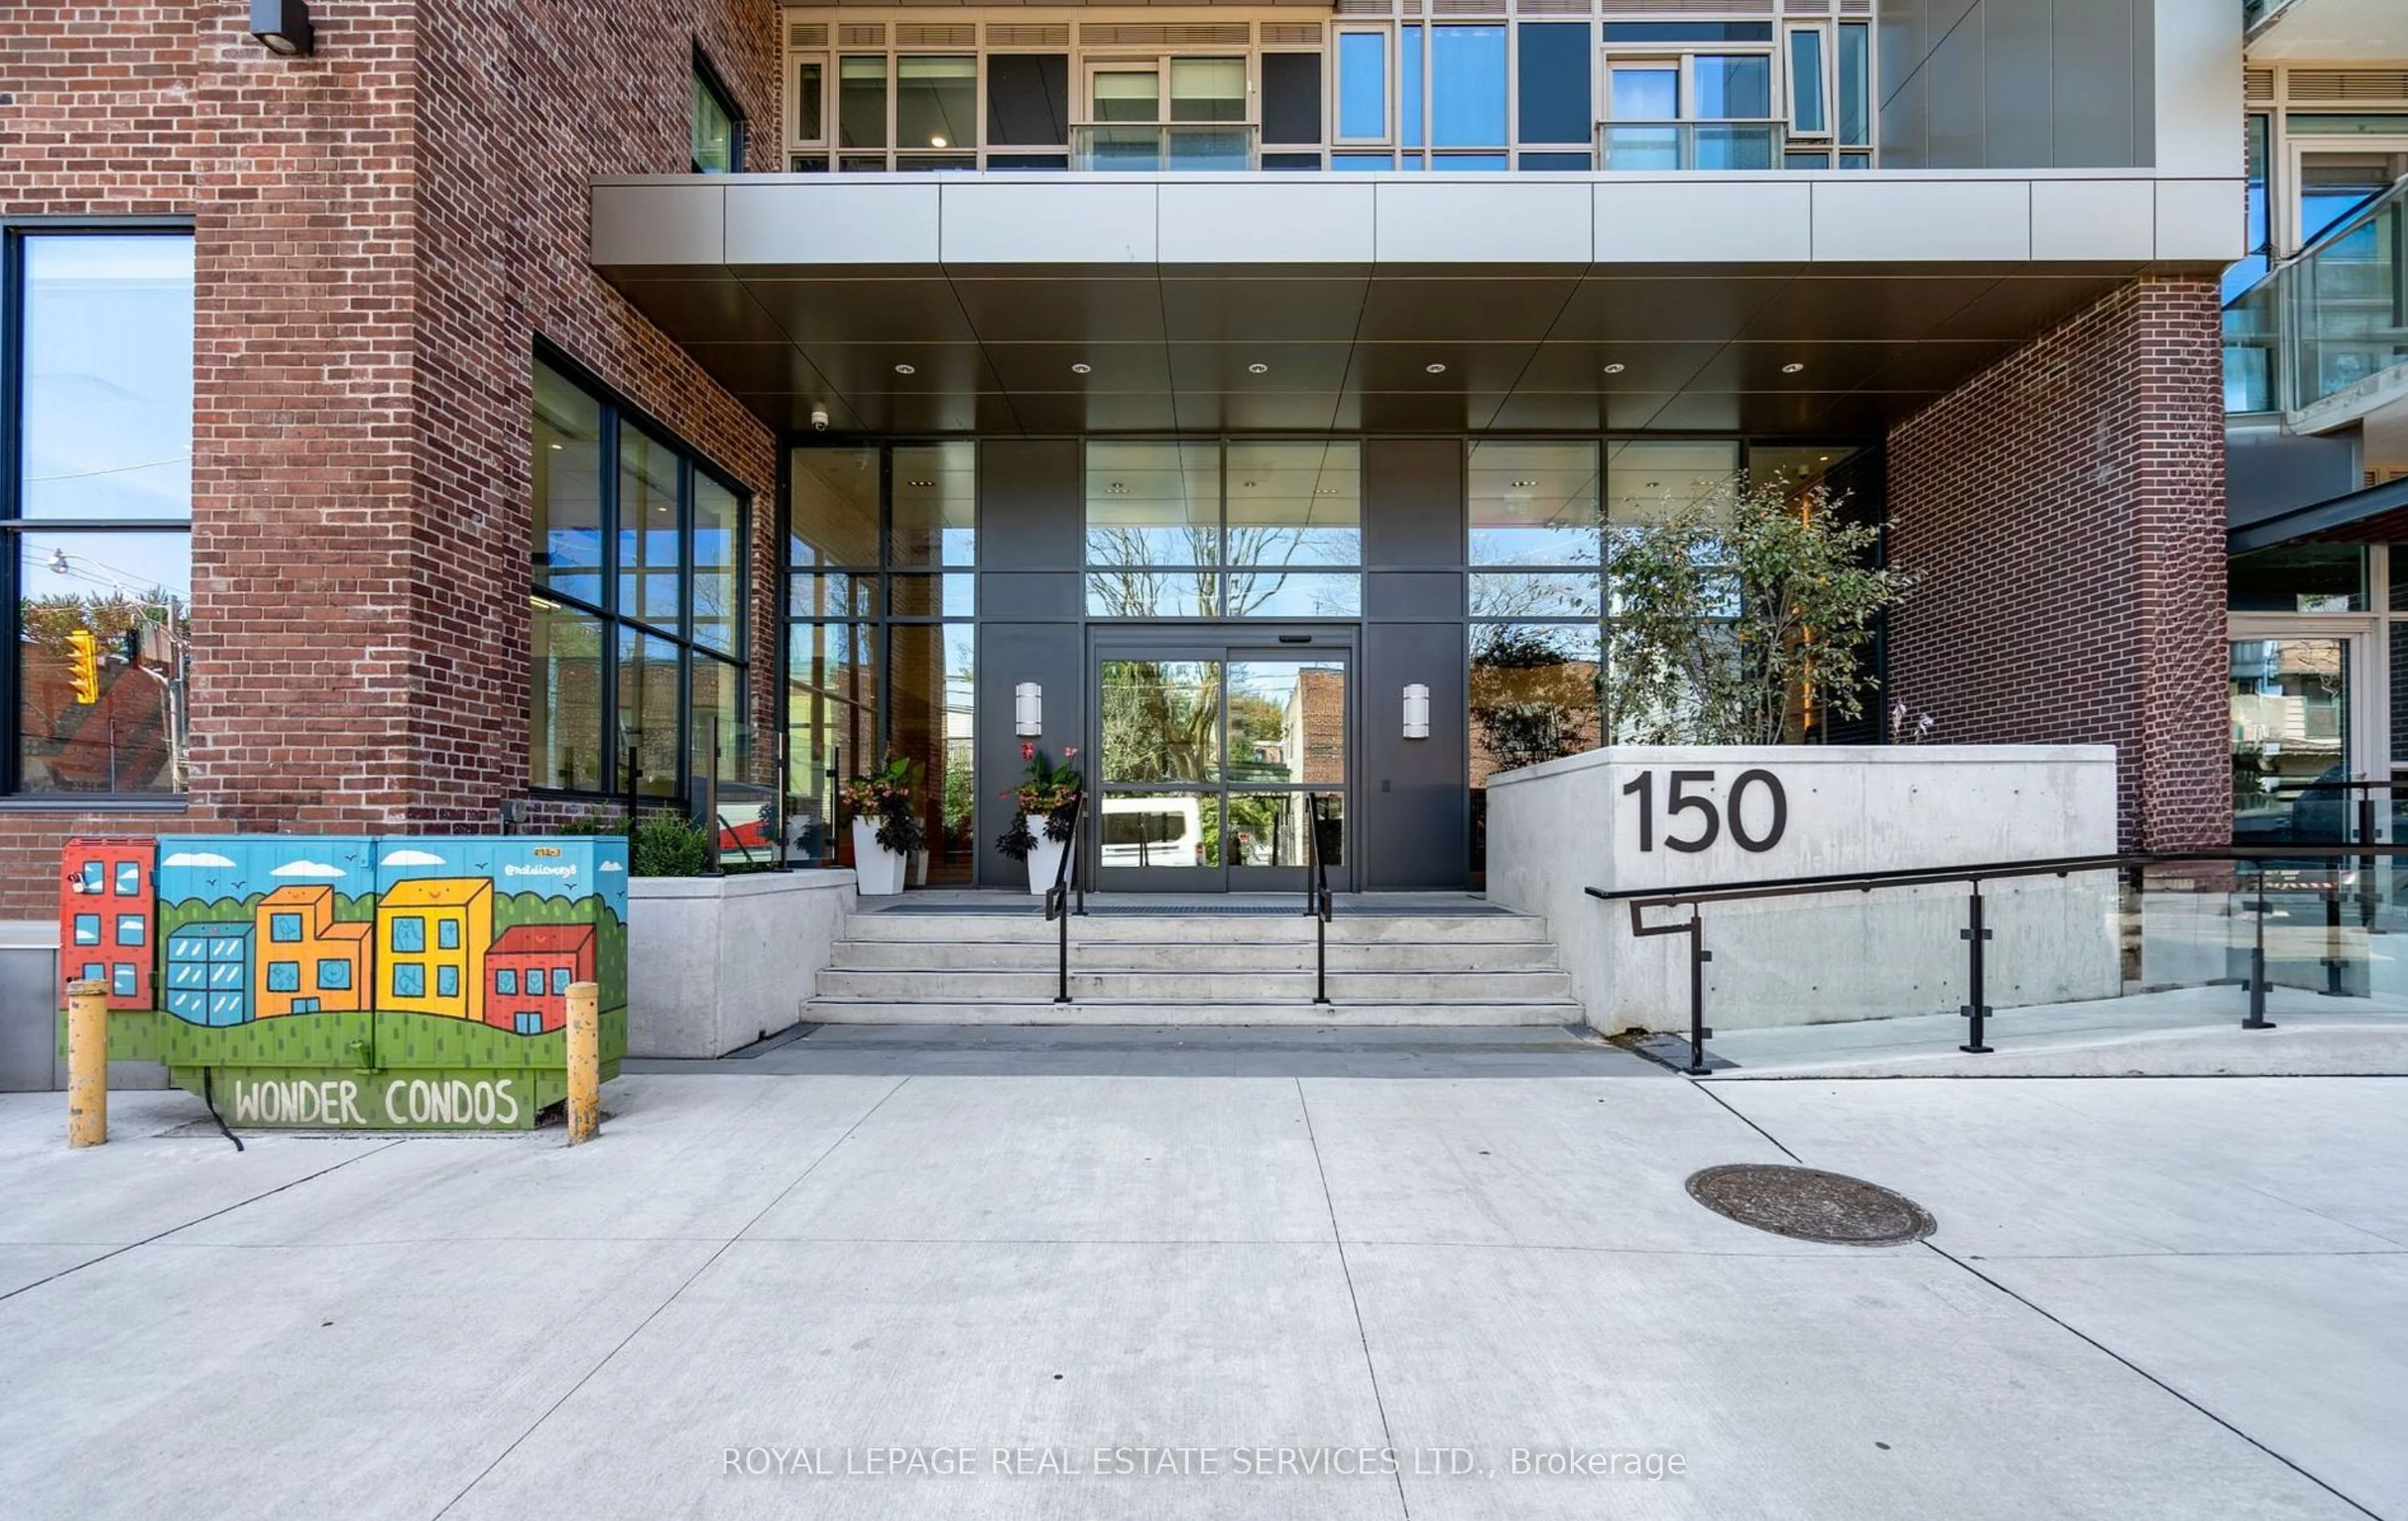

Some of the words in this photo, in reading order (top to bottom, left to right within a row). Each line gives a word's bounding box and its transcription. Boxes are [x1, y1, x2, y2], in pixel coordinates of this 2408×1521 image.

[1623, 769, 1787, 853] 150
[235, 1080, 367, 1125] WONDER
[384, 1079, 519, 1125] CONDOS
